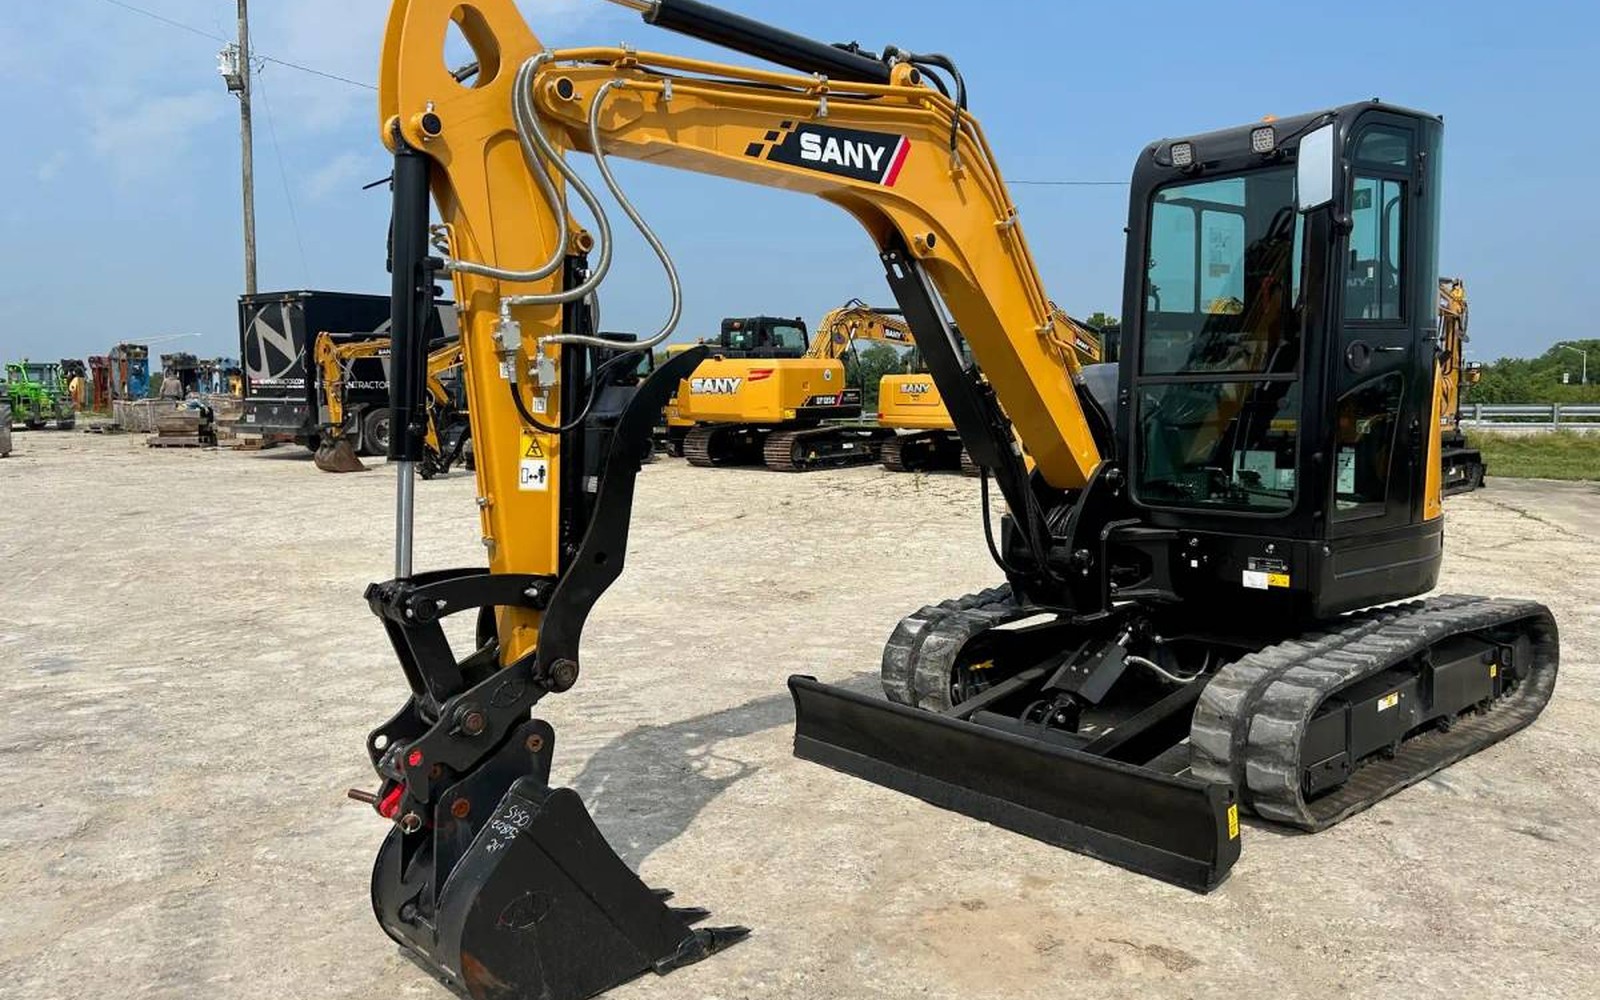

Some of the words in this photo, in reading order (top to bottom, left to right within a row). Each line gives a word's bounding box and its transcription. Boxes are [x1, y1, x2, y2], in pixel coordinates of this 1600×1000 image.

[800, 132, 885, 171] SANY
[884, 328, 901, 339] SANY
[691, 378, 742, 394] SANY
[900, 383, 930, 393] SANY
